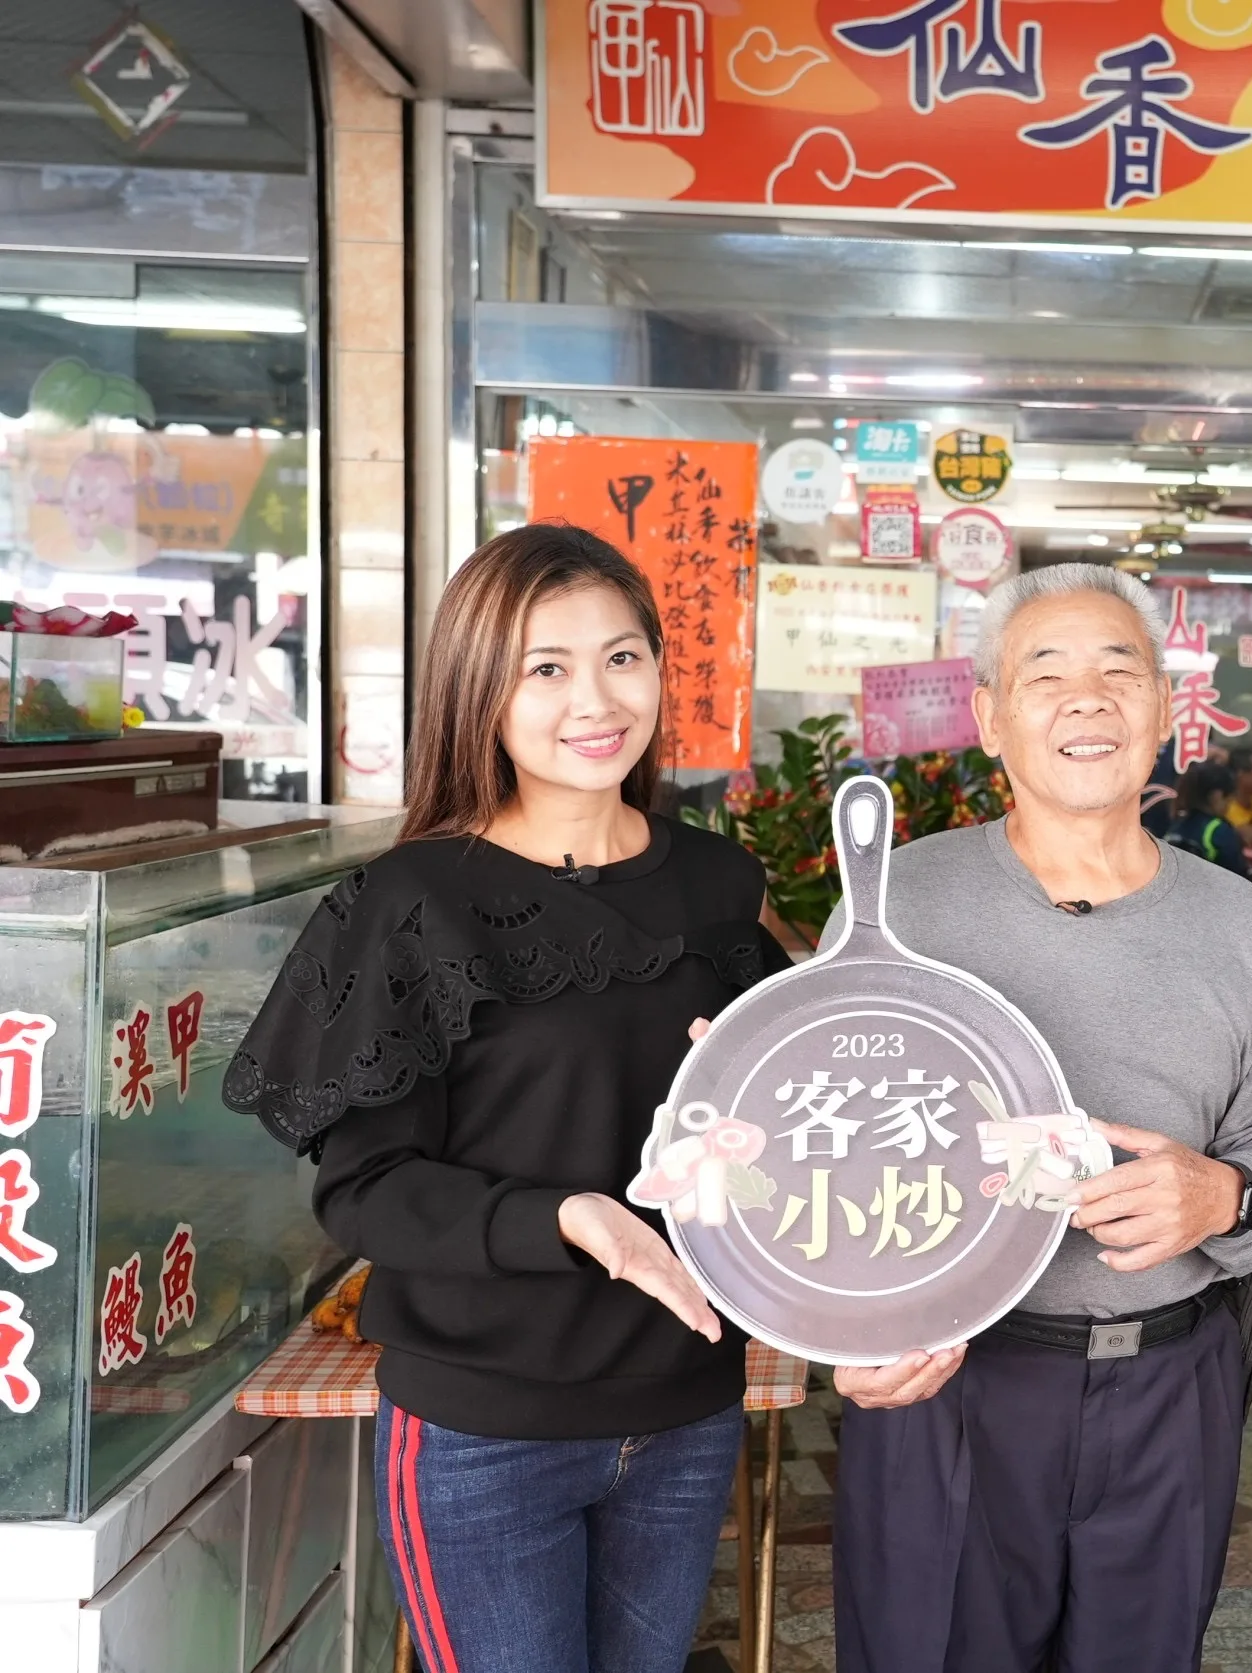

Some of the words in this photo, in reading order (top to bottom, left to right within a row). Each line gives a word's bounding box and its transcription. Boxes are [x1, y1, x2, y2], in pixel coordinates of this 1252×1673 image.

[832, 1034, 905, 1058] 2023
[774, 1069, 961, 1162] 客家
[772, 1165, 963, 1261] 小炒
